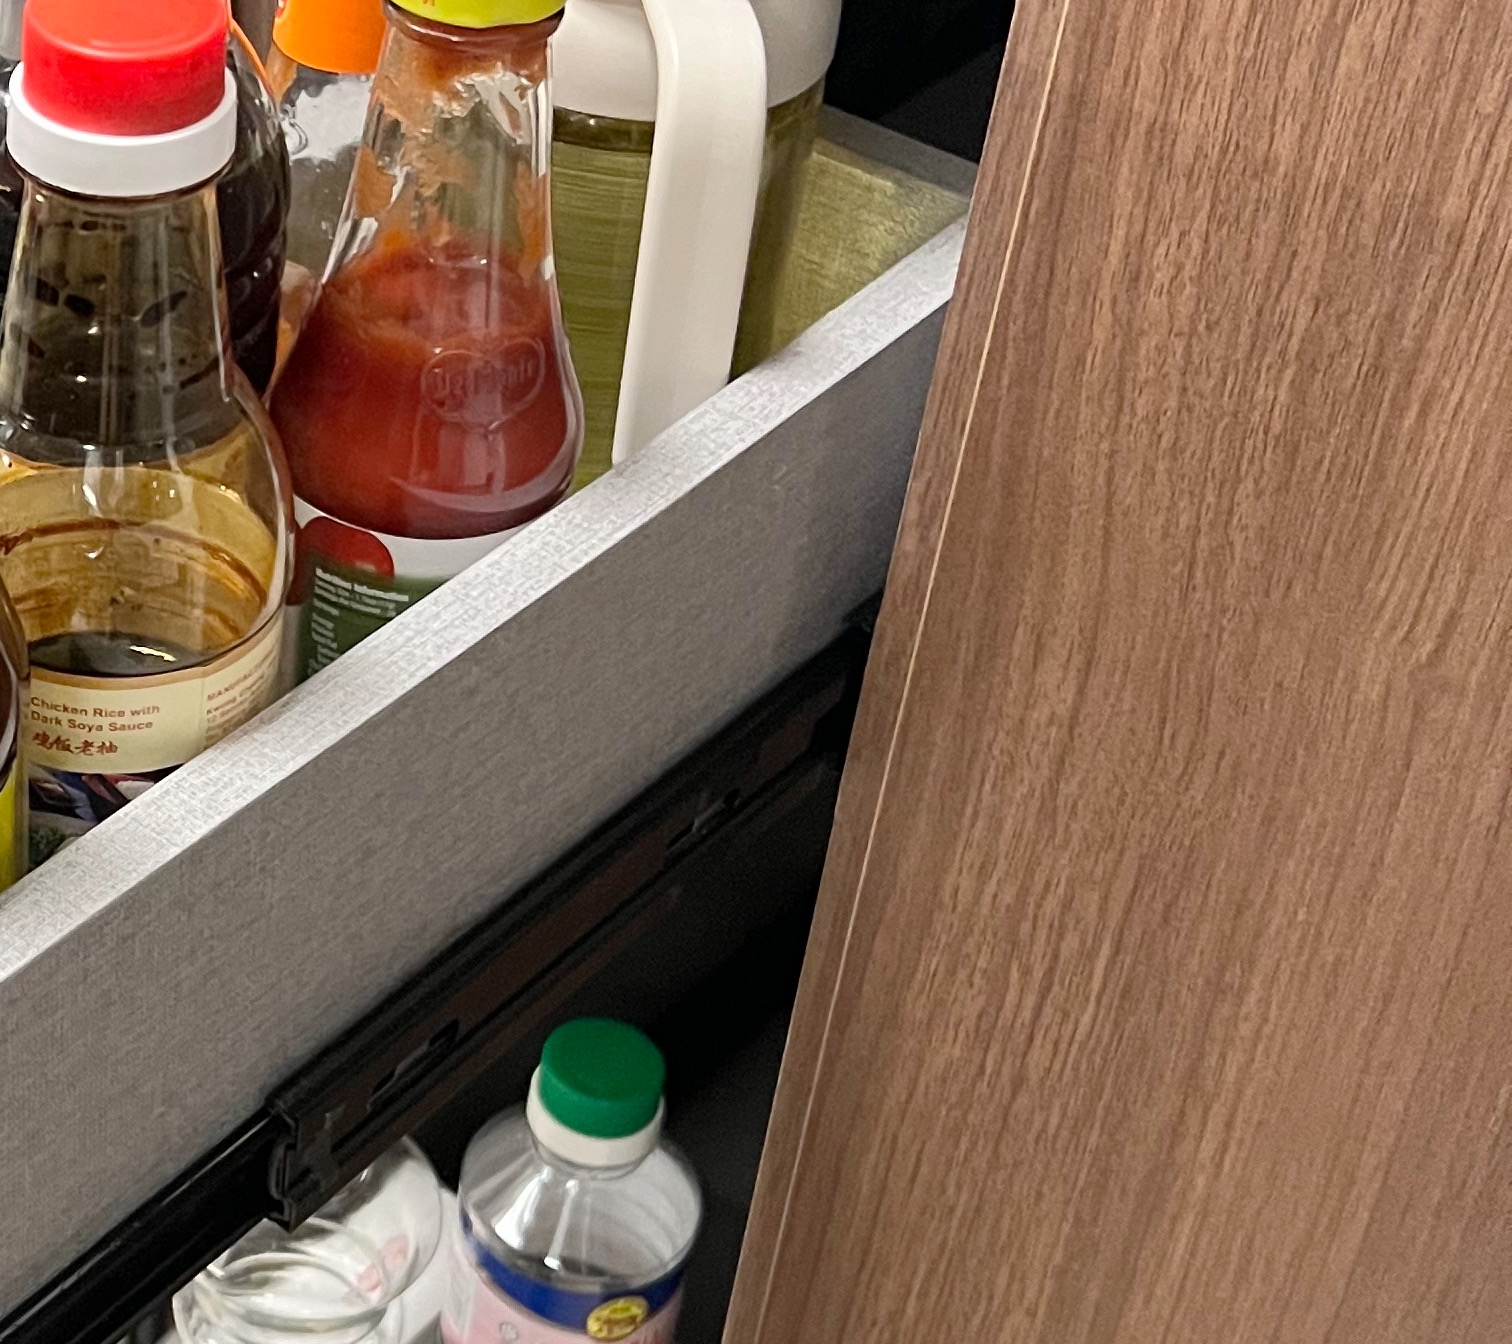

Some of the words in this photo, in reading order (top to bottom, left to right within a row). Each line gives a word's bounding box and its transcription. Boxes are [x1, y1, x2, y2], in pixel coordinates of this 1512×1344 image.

[30, 696, 88, 716] Chicken
[93, 707, 126, 718] Rice
[130, 704, 160, 717] with
[30, 710, 63, 726] Dark
[67, 718, 104, 733] Soya
[108, 721, 154, 732] Sauce
